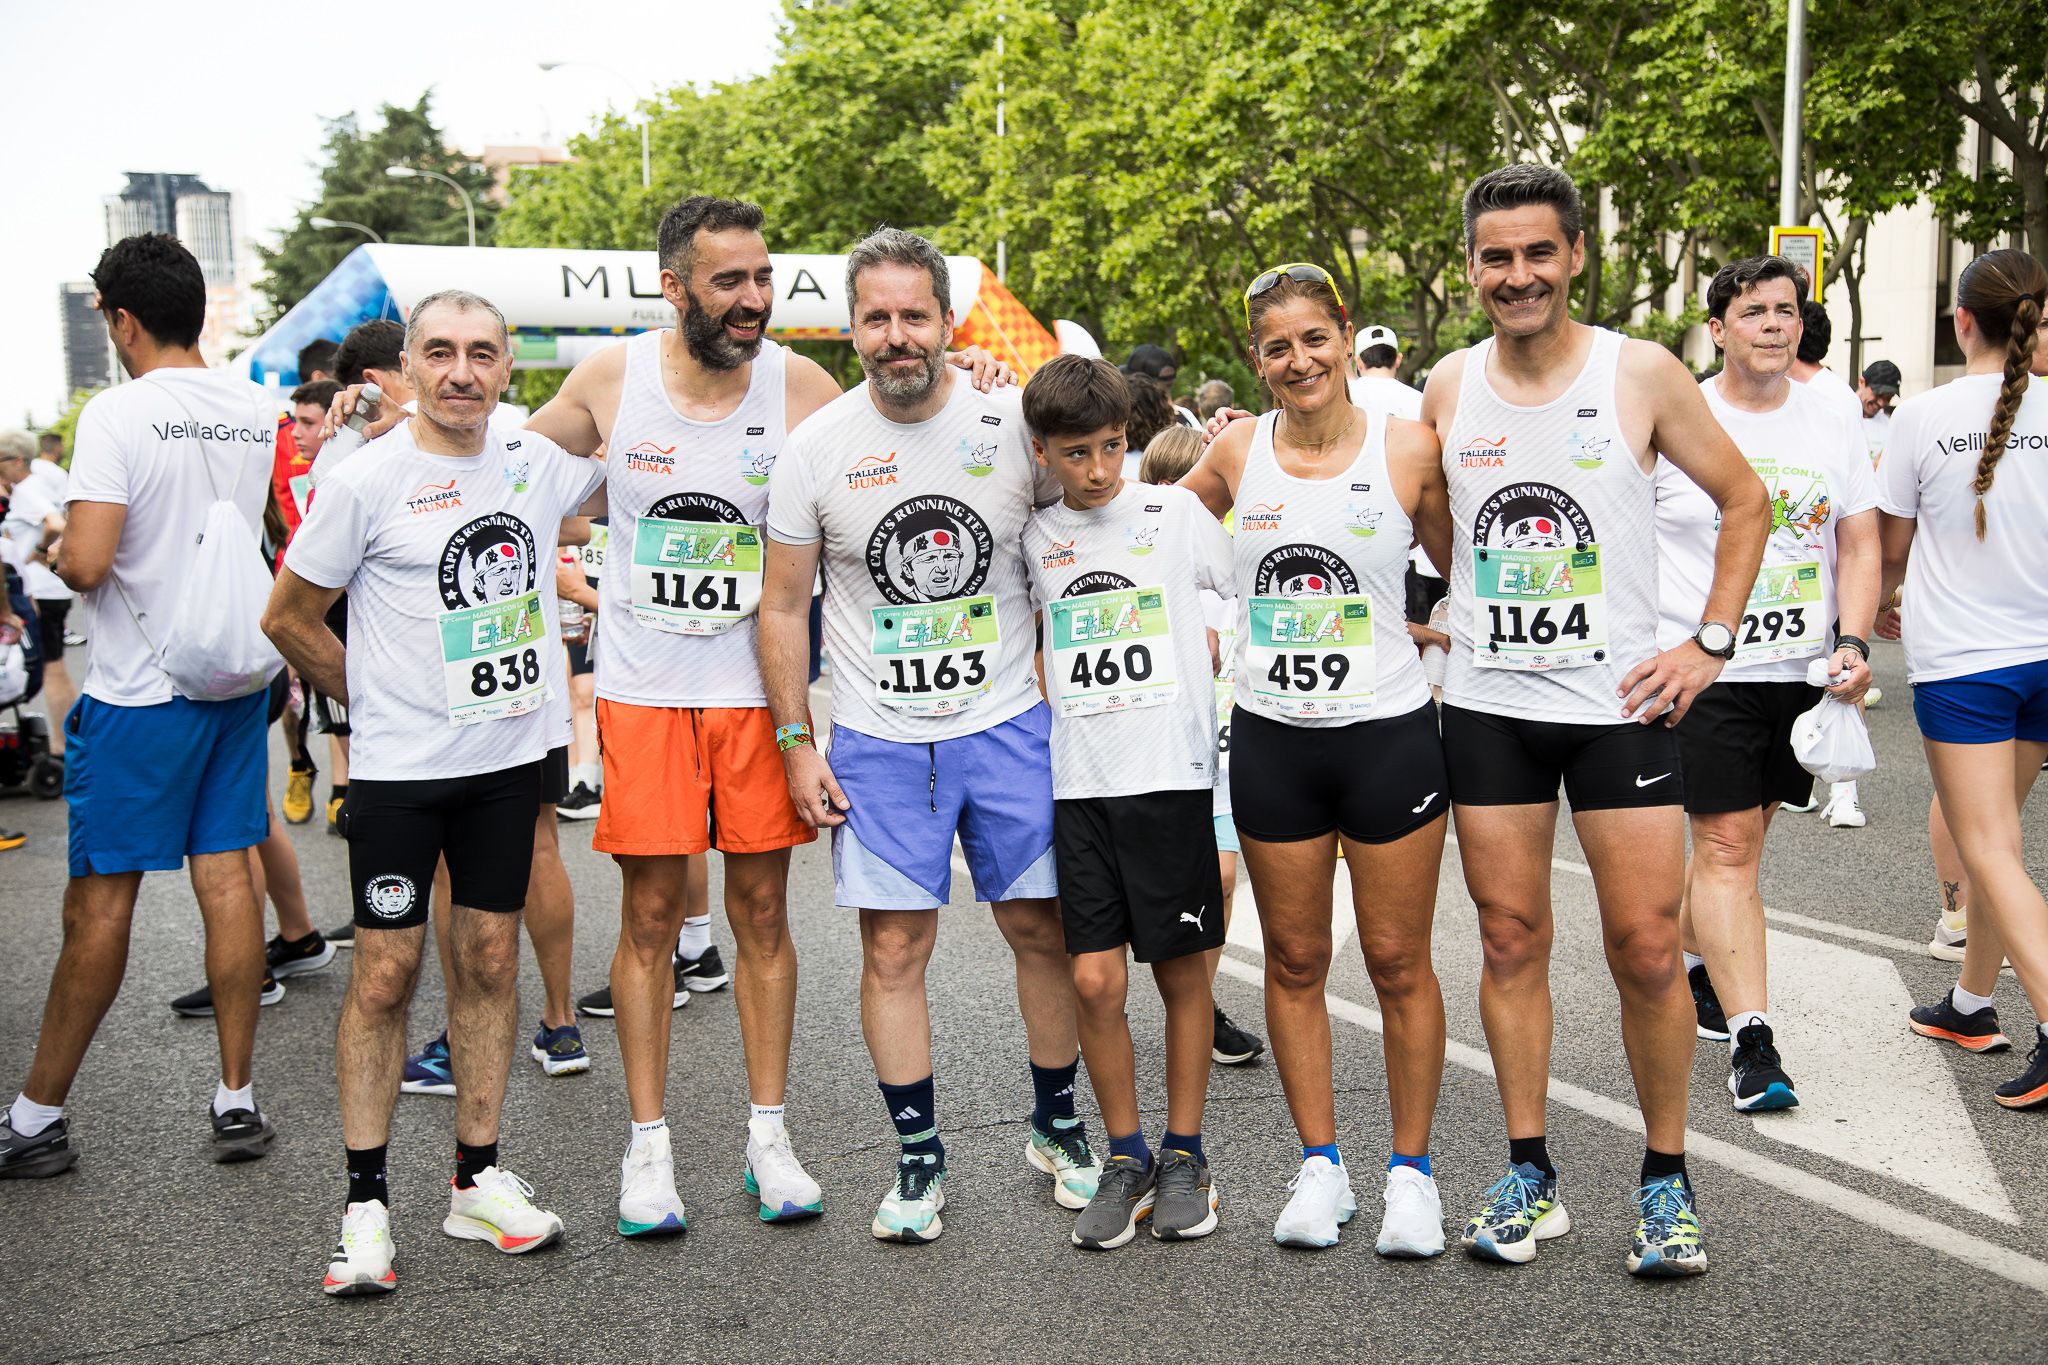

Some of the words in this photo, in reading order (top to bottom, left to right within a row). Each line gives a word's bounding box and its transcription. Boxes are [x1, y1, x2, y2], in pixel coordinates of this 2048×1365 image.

[562, 264, 826, 300] MUA
[625, 452, 675, 465] TALLERES
[1459, 449, 1506, 462] TALLERES
[1461, 457, 1505, 468] JUMA
[627, 460, 673, 475] JUMA
[846, 464, 898, 484] TALLERES
[1781, 466, 1809, 477] CON
[849, 474, 899, 490] JUMA
[407, 490, 461, 509] TALLERES
[413, 498, 462, 514] JUMA
[668, 496, 737, 519] RUNNING
[1501, 486, 1569, 508] RUNNING
[666, 525, 698, 533] MADRID
[1242, 514, 1282, 525] TALLERES
[1242, 521, 1279, 531] JUMA
[871, 518, 896, 568] CAPI'S
[895, 499, 966, 523] RUNNING
[966, 512, 991, 553] TEAM
[442, 533, 466, 584] CAPI'S
[463, 515, 518, 538] RUNNING
[519, 523, 535, 564] TEAM
[658, 531, 735, 566] ELA
[1041, 550, 1075, 564] TALLERES
[1500, 554, 1531, 563] MADRID
[1533, 555, 1552, 563] CON
[1043, 556, 1076, 569] JUMA
[1258, 558, 1275, 596] API'S
[1274, 547, 1340, 568] RUNNING
[1340, 563, 1357, 595] TEA
[1071, 574, 1127, 594] RUNNING
[1497, 561, 1573, 595] ELA
[651, 572, 741, 611] 1161
[472, 607, 501, 620] MADRID
[502, 603, 517, 613] CON
[902, 608, 934, 617] MADRID
[935, 606, 951, 614] CON
[1071, 600, 1100, 609] MADRID
[470, 608, 532, 652] ELA
[897, 611, 972, 649] ELA
[1070, 602, 1141, 642] ELA
[1270, 611, 1344, 642] ELA
[1488, 603, 1590, 645] 1164
[1741, 608, 1806, 645] 293
[471, 648, 540, 697] 838
[889, 650, 986, 693] 1163
[1070, 644, 1152, 688] 460
[1268, 653, 1350, 691] 459
